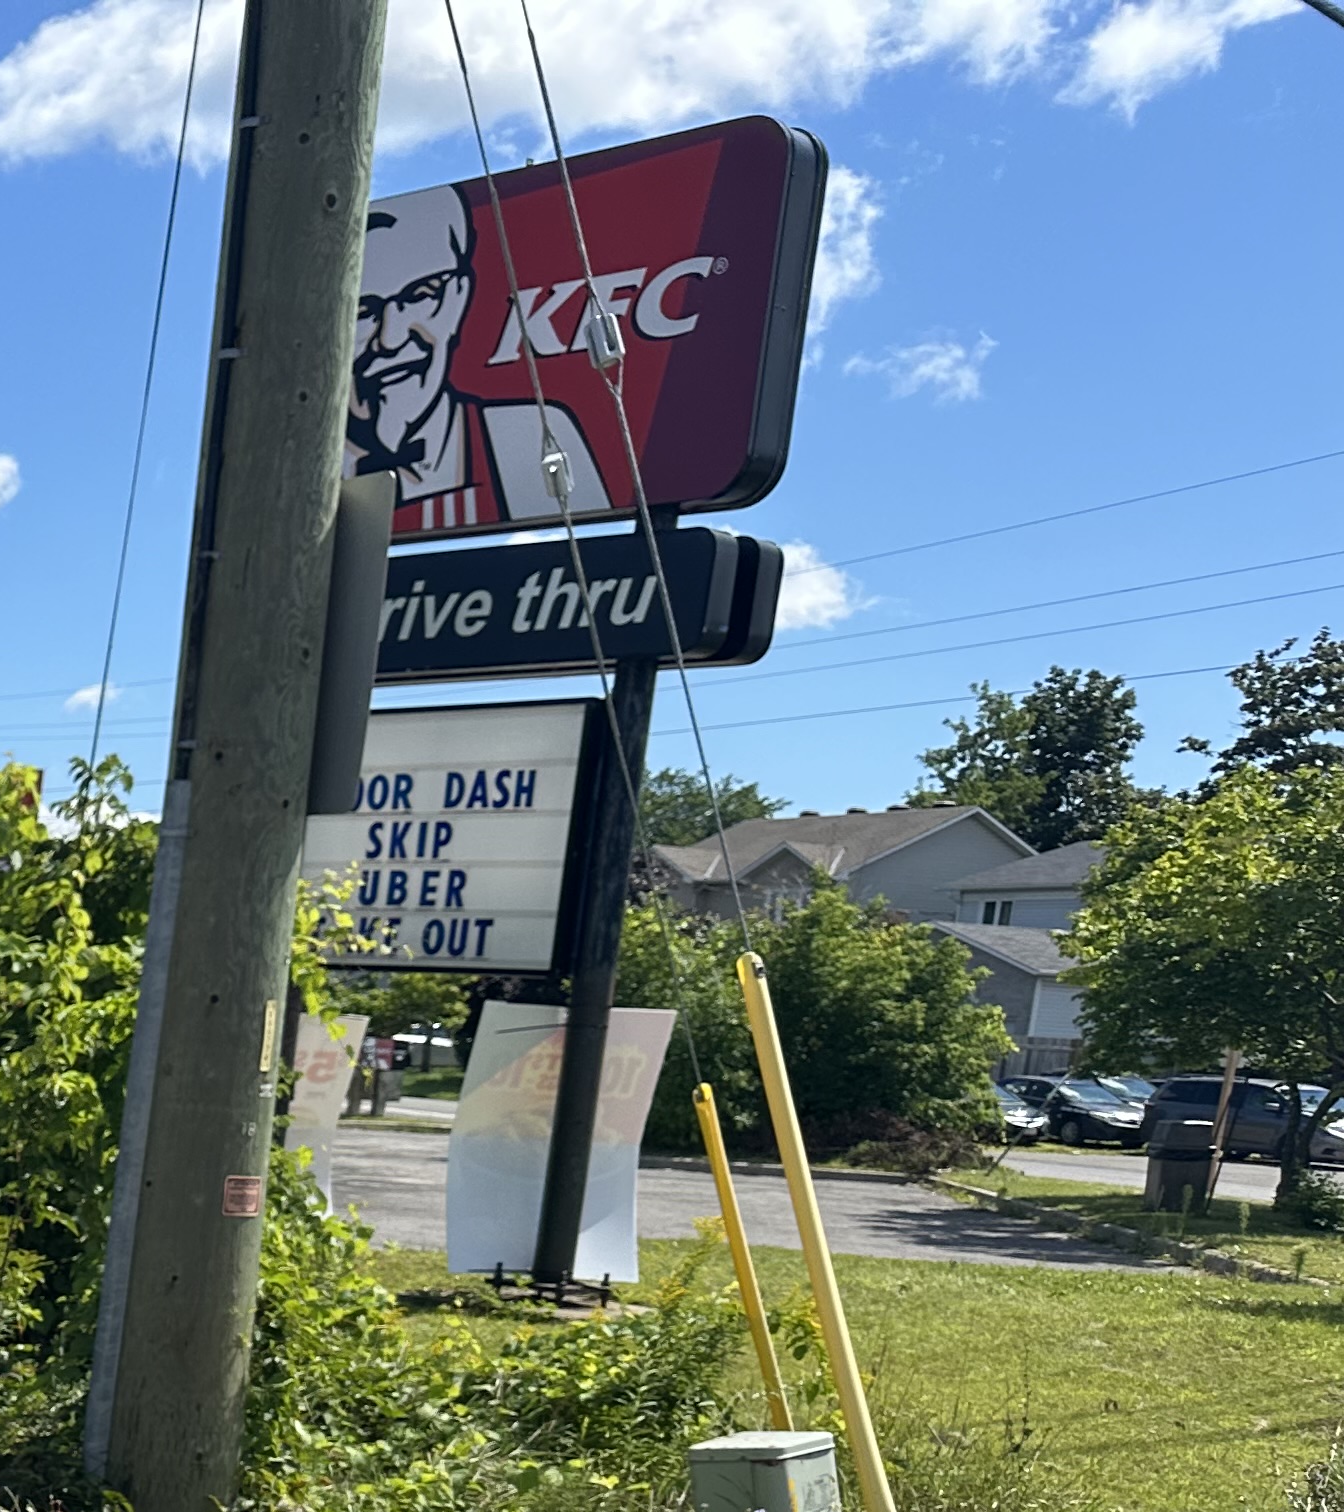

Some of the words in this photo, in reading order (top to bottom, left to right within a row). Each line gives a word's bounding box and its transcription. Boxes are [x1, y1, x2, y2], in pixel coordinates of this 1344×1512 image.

[487, 256, 714, 366] KFC
[377, 579, 494, 642] rive
[512, 566, 658, 633] thru
[355, 773, 415, 812] OR
[444, 769, 537, 809] DASH
[365, 820, 454, 860] SKIP
[359, 869, 467, 908] UBER
[421, 918, 495, 957] OUT
